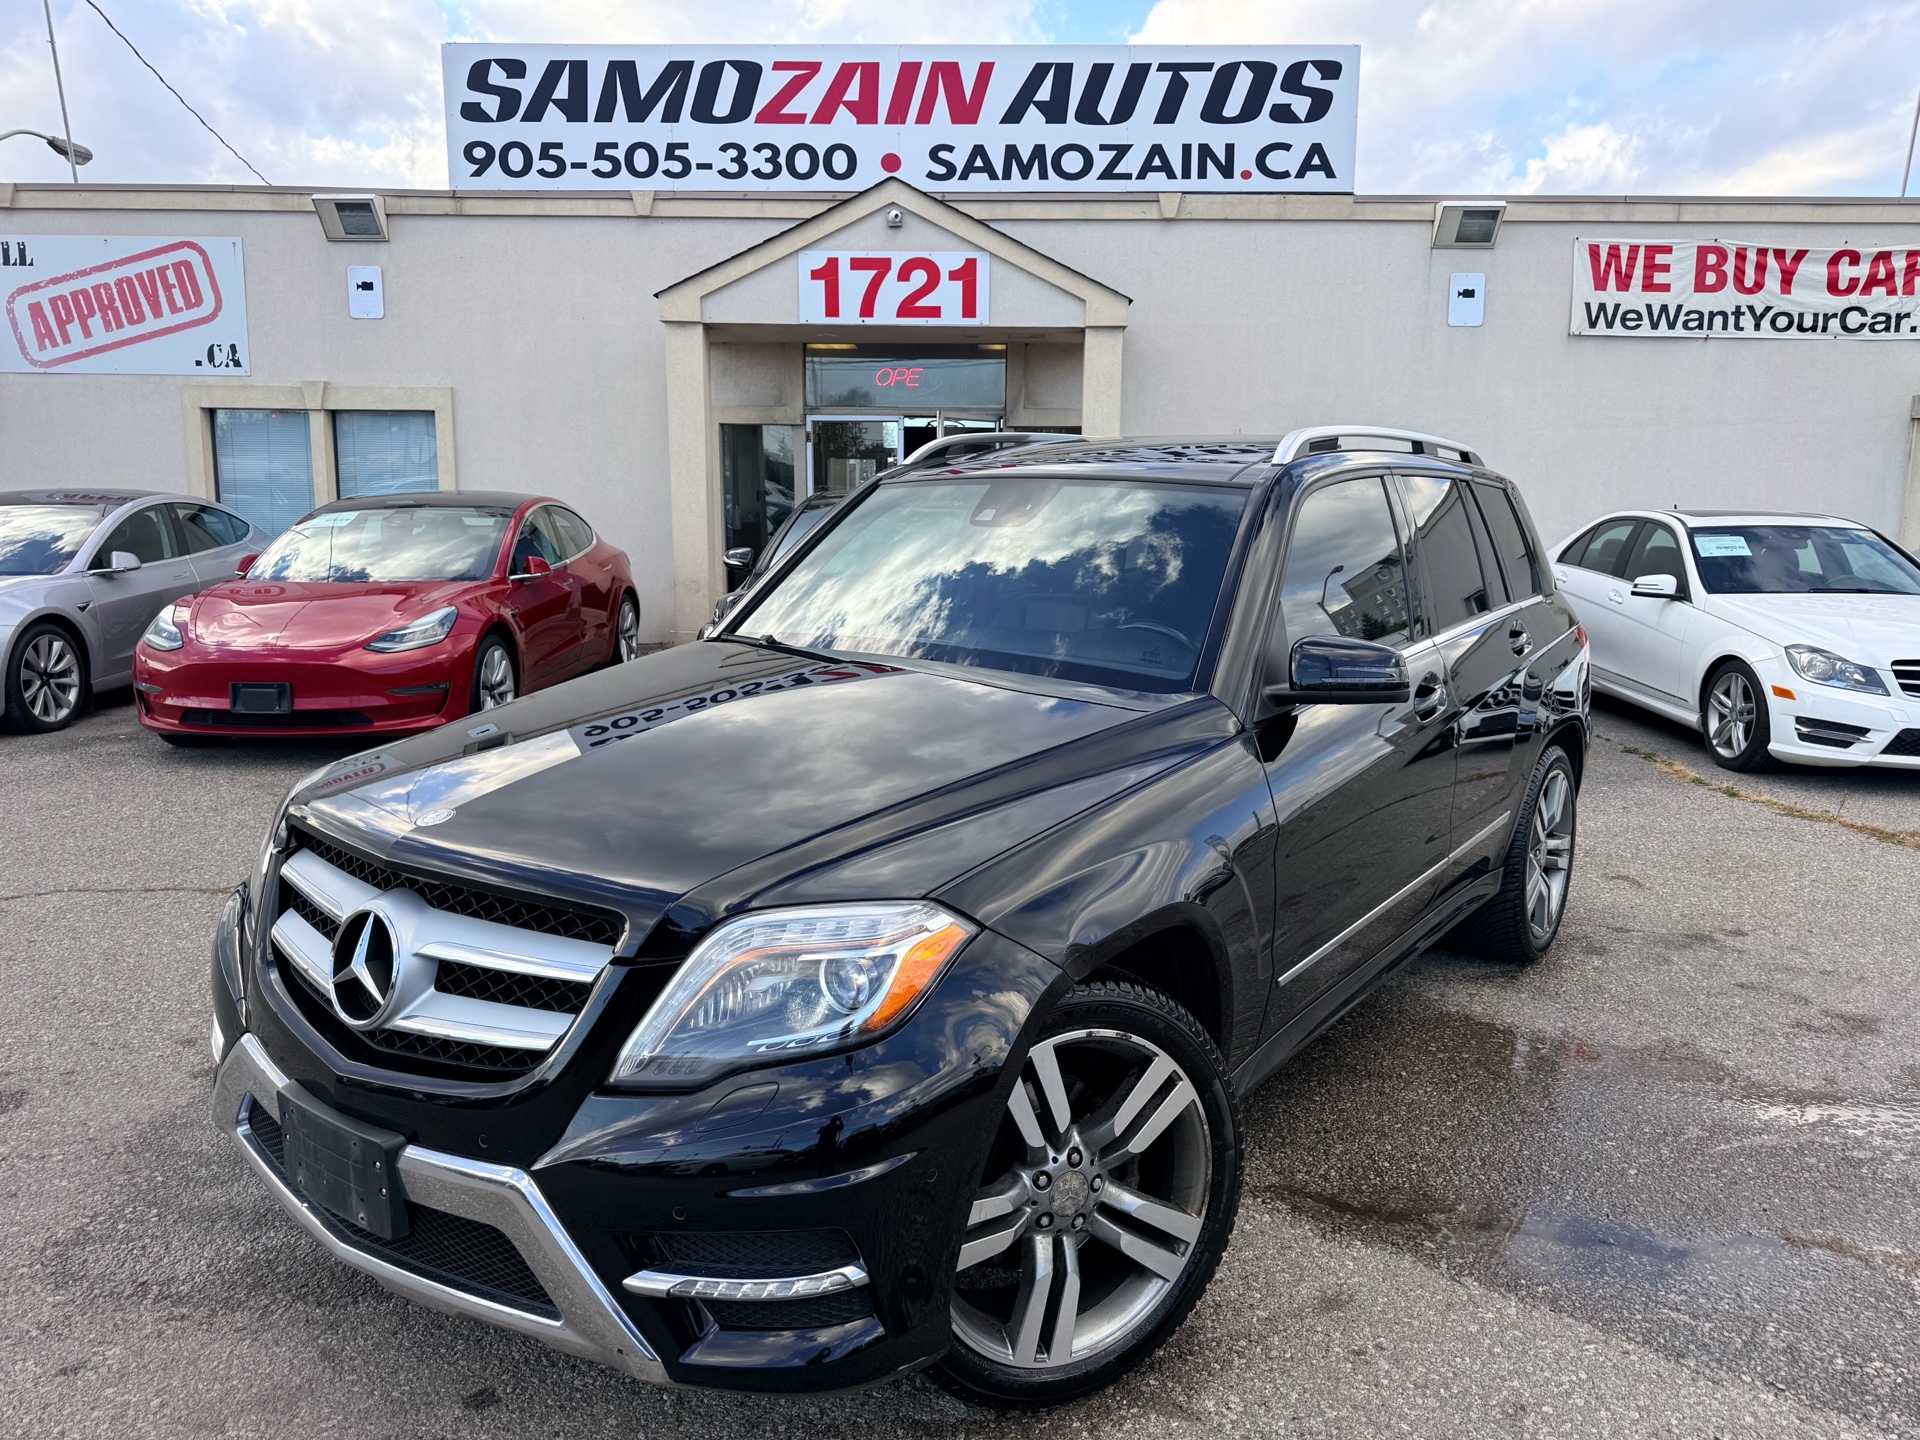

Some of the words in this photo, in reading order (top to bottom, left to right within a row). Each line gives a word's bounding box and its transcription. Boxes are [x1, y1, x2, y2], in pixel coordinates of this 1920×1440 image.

[460, 59, 995, 125] SAMOZAIN
[999, 59, 1342, 125] AUTOS
[464, 141, 857, 180] 905-505-3300
[926, 142, 1336, 181] SAMOZAIN.CA
[810, 257, 977, 318] 1721
[1587, 244, 1673, 292] WE
[1694, 245, 1807, 295] BUY
[27, 259, 204, 352] APPROVED
[1585, 302, 1918, 334] WeWantYourCar.
[195, 343, 243, 368] .CA
